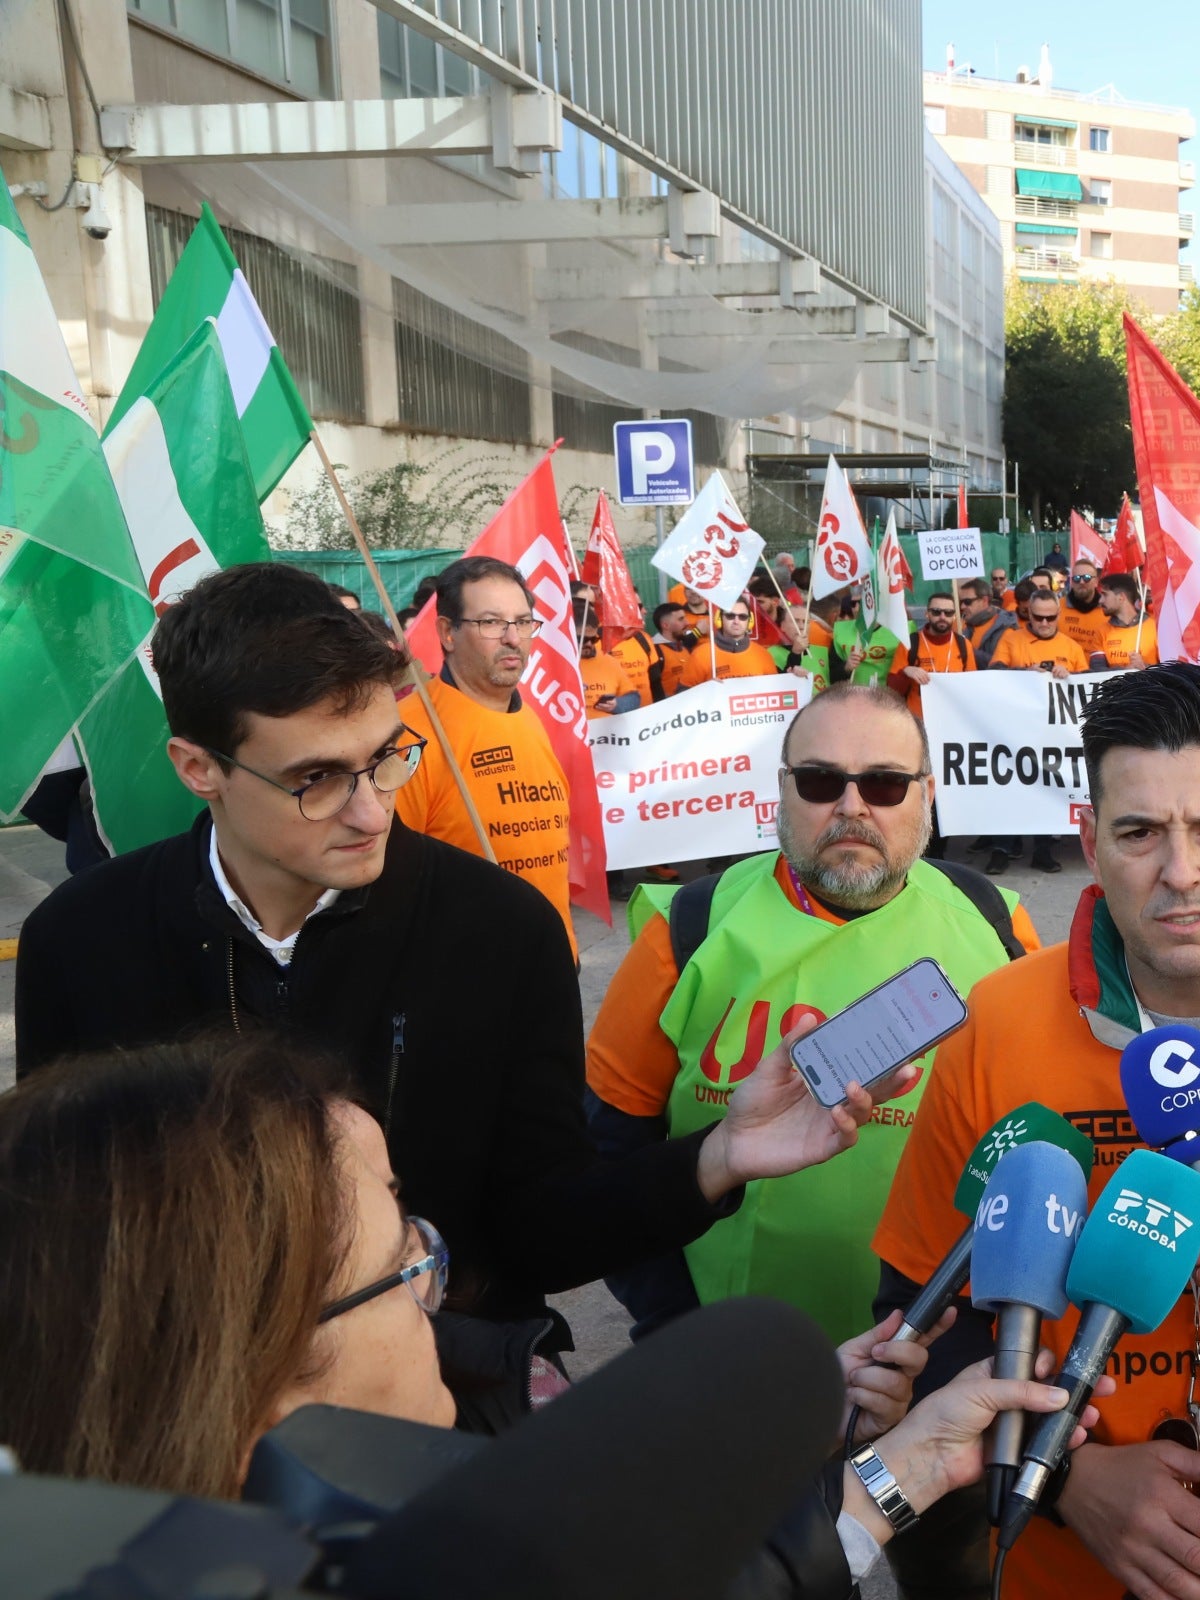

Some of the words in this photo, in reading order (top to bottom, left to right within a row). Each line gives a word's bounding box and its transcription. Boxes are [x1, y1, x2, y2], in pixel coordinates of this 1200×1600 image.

[630, 431, 676, 495] P
[926, 546, 942, 555] NO
[944, 545, 954, 553] ES
[956, 543, 977, 553] UNA
[929, 554, 978, 571] OPCIÓN
[638, 709, 722, 742] Córdoba
[730, 713, 786, 728] industria
[474, 763, 516, 778] industria
[596, 771, 616, 789] e
[628, 753, 751, 793] primera
[497, 781, 565, 804] Hitachi
[604, 807, 625, 824] e
[637, 790, 756, 822] tercera
[488, 818, 551, 838] Negociar
[499, 854, 555, 874] mponer
[1071, 1116, 1139, 1138] CCO
[1107, 1211, 1177, 1253] CÓRDOBA
